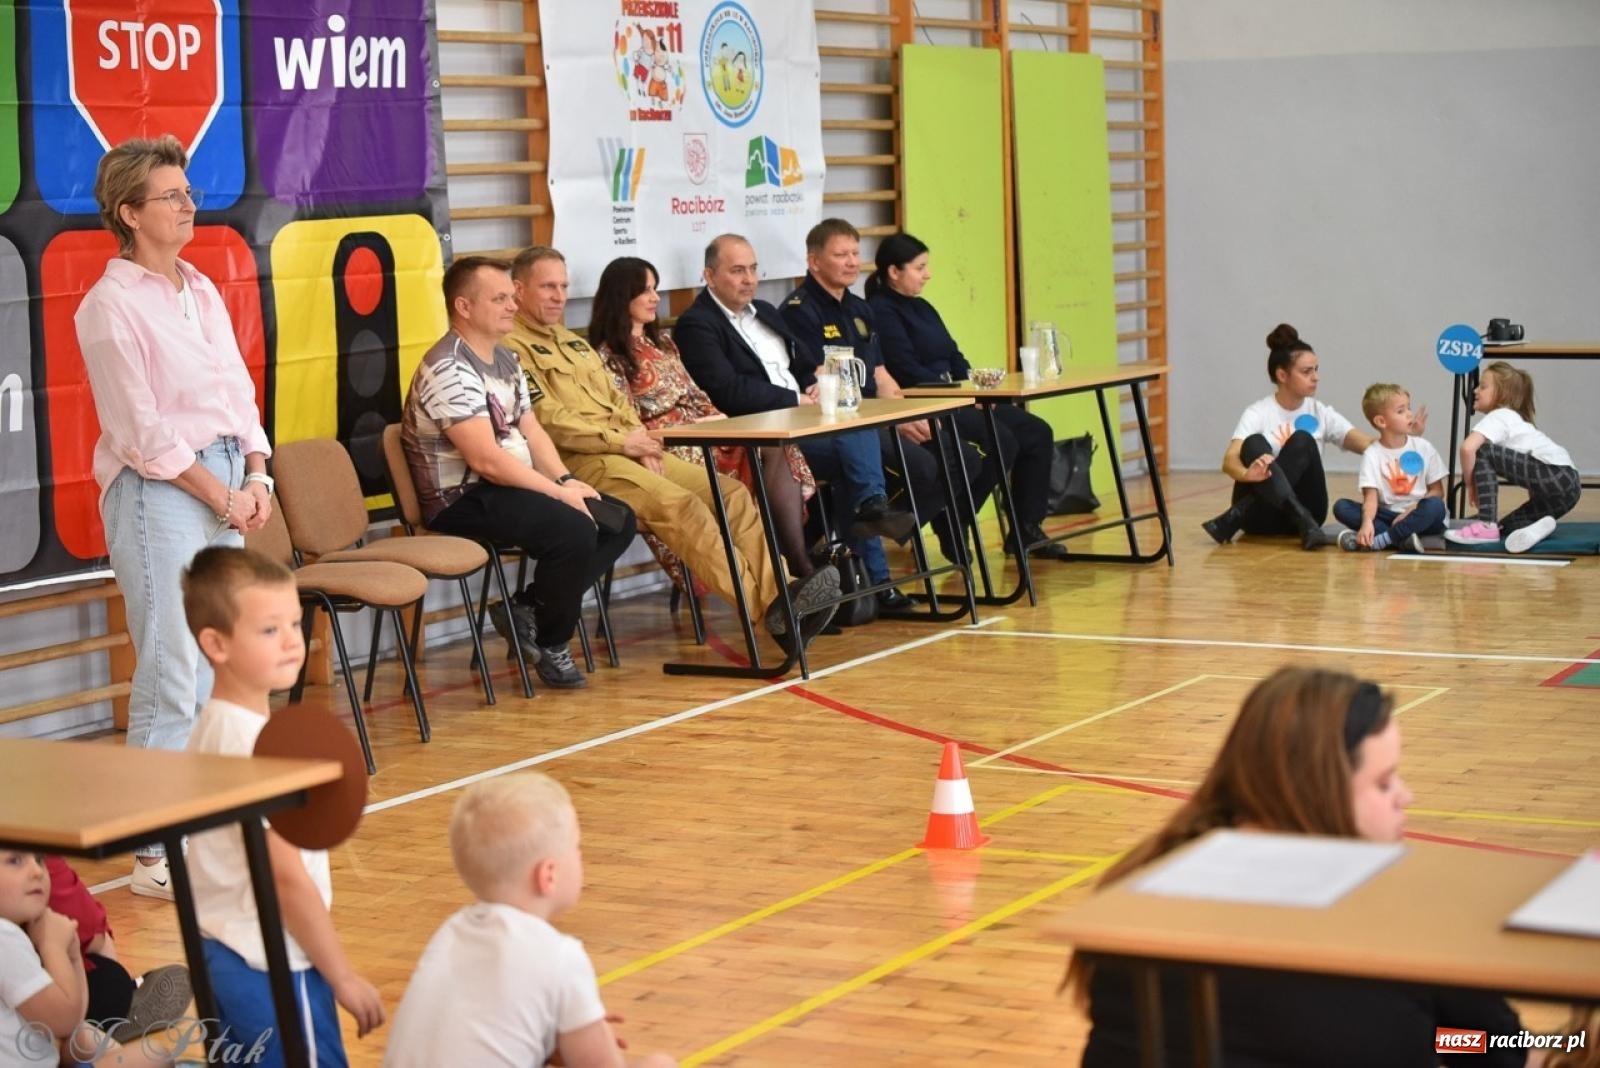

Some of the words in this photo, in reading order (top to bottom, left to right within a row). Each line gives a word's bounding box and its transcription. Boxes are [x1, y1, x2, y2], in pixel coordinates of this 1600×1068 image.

[99, 19, 201, 71] STOP
[274, 14, 406, 90] wiem
[667, 22, 683, 53] 11
[672, 195, 725, 214] Racibórz
[1439, 339, 1483, 359] ZSP4
